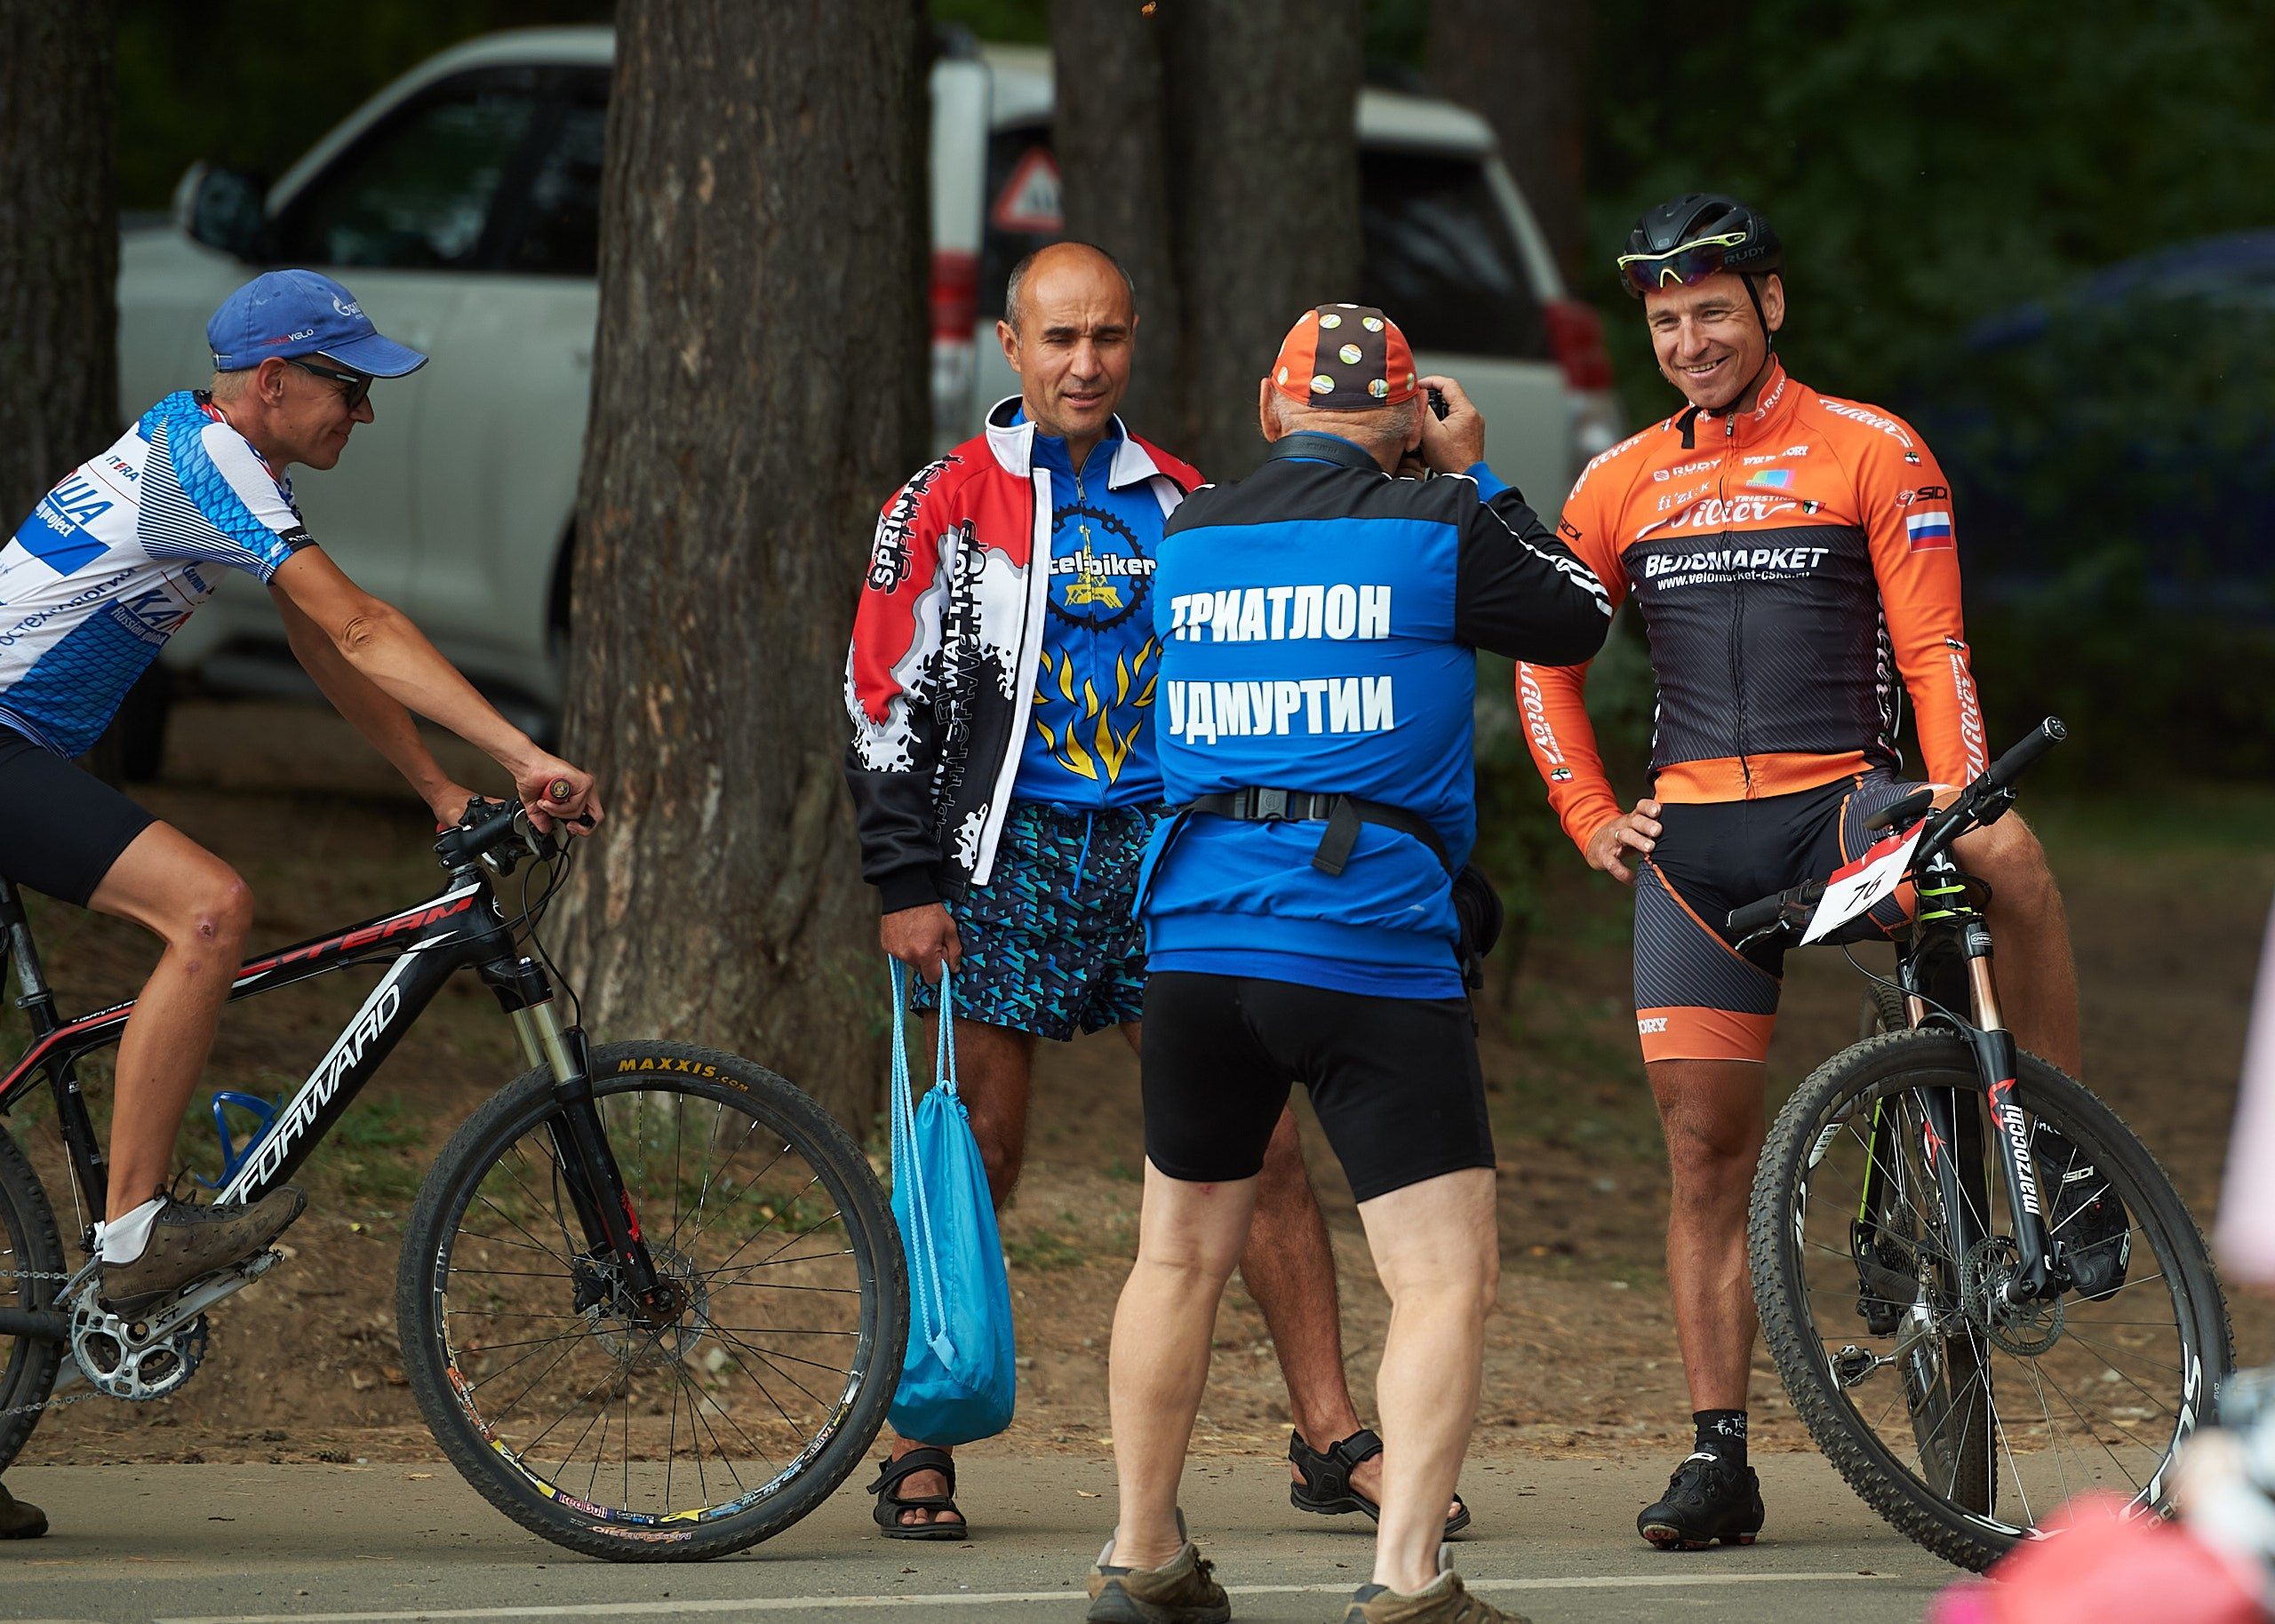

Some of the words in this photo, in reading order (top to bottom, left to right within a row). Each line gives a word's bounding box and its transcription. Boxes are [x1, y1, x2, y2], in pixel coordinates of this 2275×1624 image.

[1724, 245, 1766, 265] RUDY
[1763, 375, 1785, 409] RUDY
[106, 455, 140, 482] ITERA
[1672, 458, 1721, 476] RUDY
[1916, 486, 1948, 502] SIDI
[110, 606, 146, 636] Russian
[1170, 584, 1392, 642] ТРИАТЛОН
[1167, 675, 1394, 745] УДМУРТИИ
[1843, 870, 1887, 913] 76
[239, 983, 400, 1205] FORWARD
[2000, 1103, 2041, 1215] marzocchi
[156, 1307, 180, 1329] XT
[582, 1500, 608, 1520] Bull
[616, 1509, 654, 1520] GoPro
